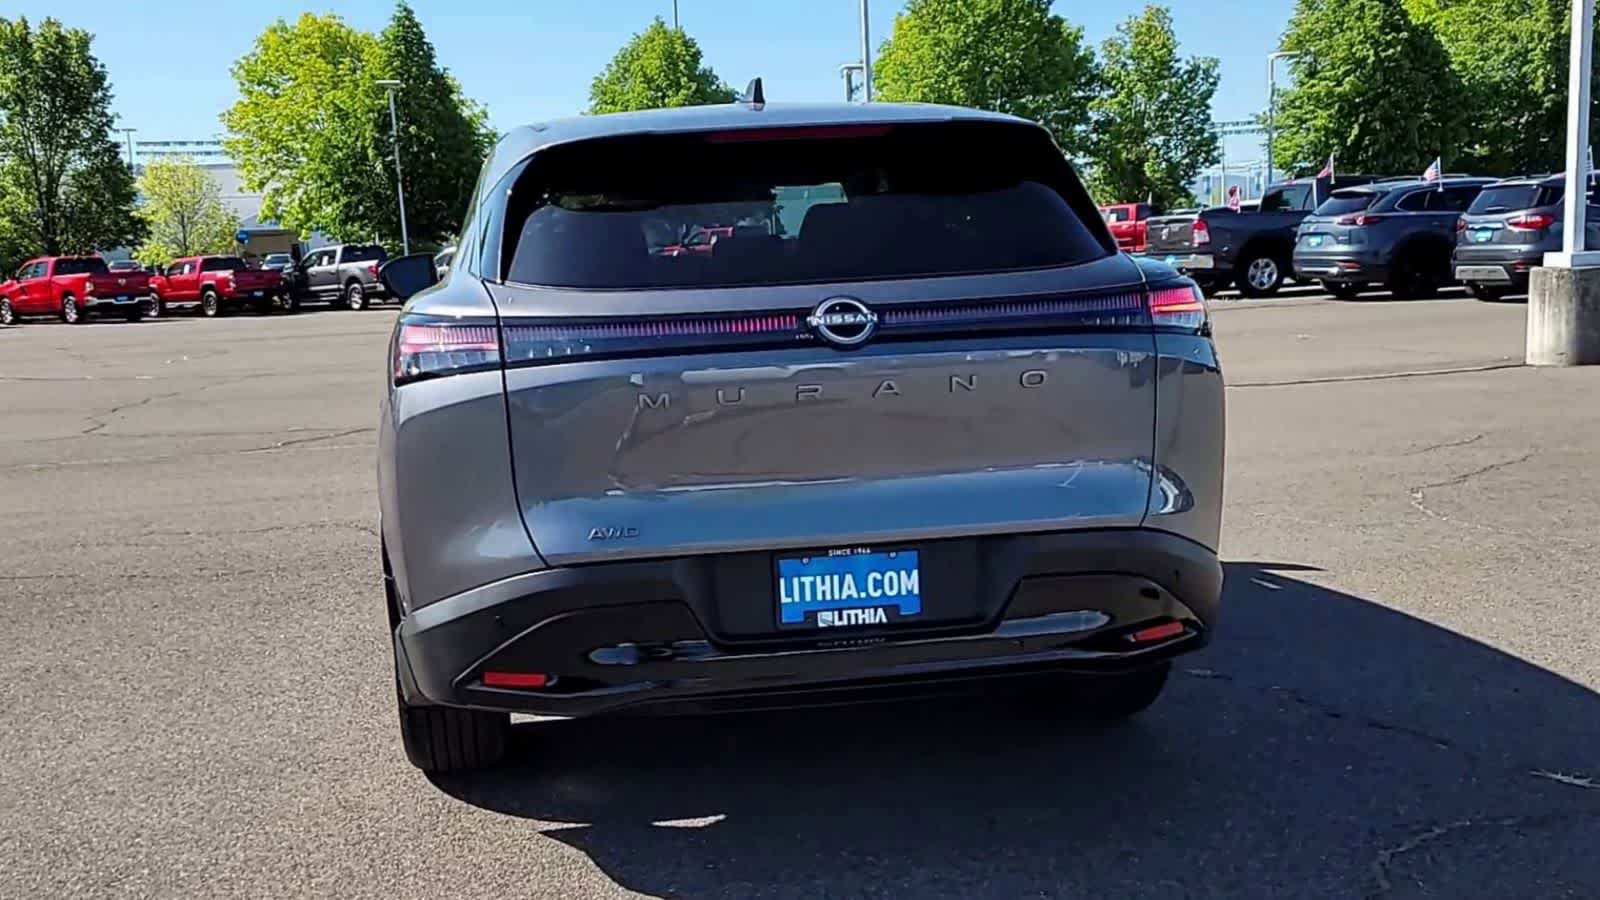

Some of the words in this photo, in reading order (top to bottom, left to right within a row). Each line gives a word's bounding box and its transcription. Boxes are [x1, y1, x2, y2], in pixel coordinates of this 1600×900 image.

[806, 312, 877, 325] NISSAN
[637, 369, 1049, 410] MURANO
[587, 527, 640, 541] AWD
[828, 548, 851, 557] SINCE
[779, 568, 919, 604] LITHIA.COM
[834, 607, 888, 626] LITHIA
